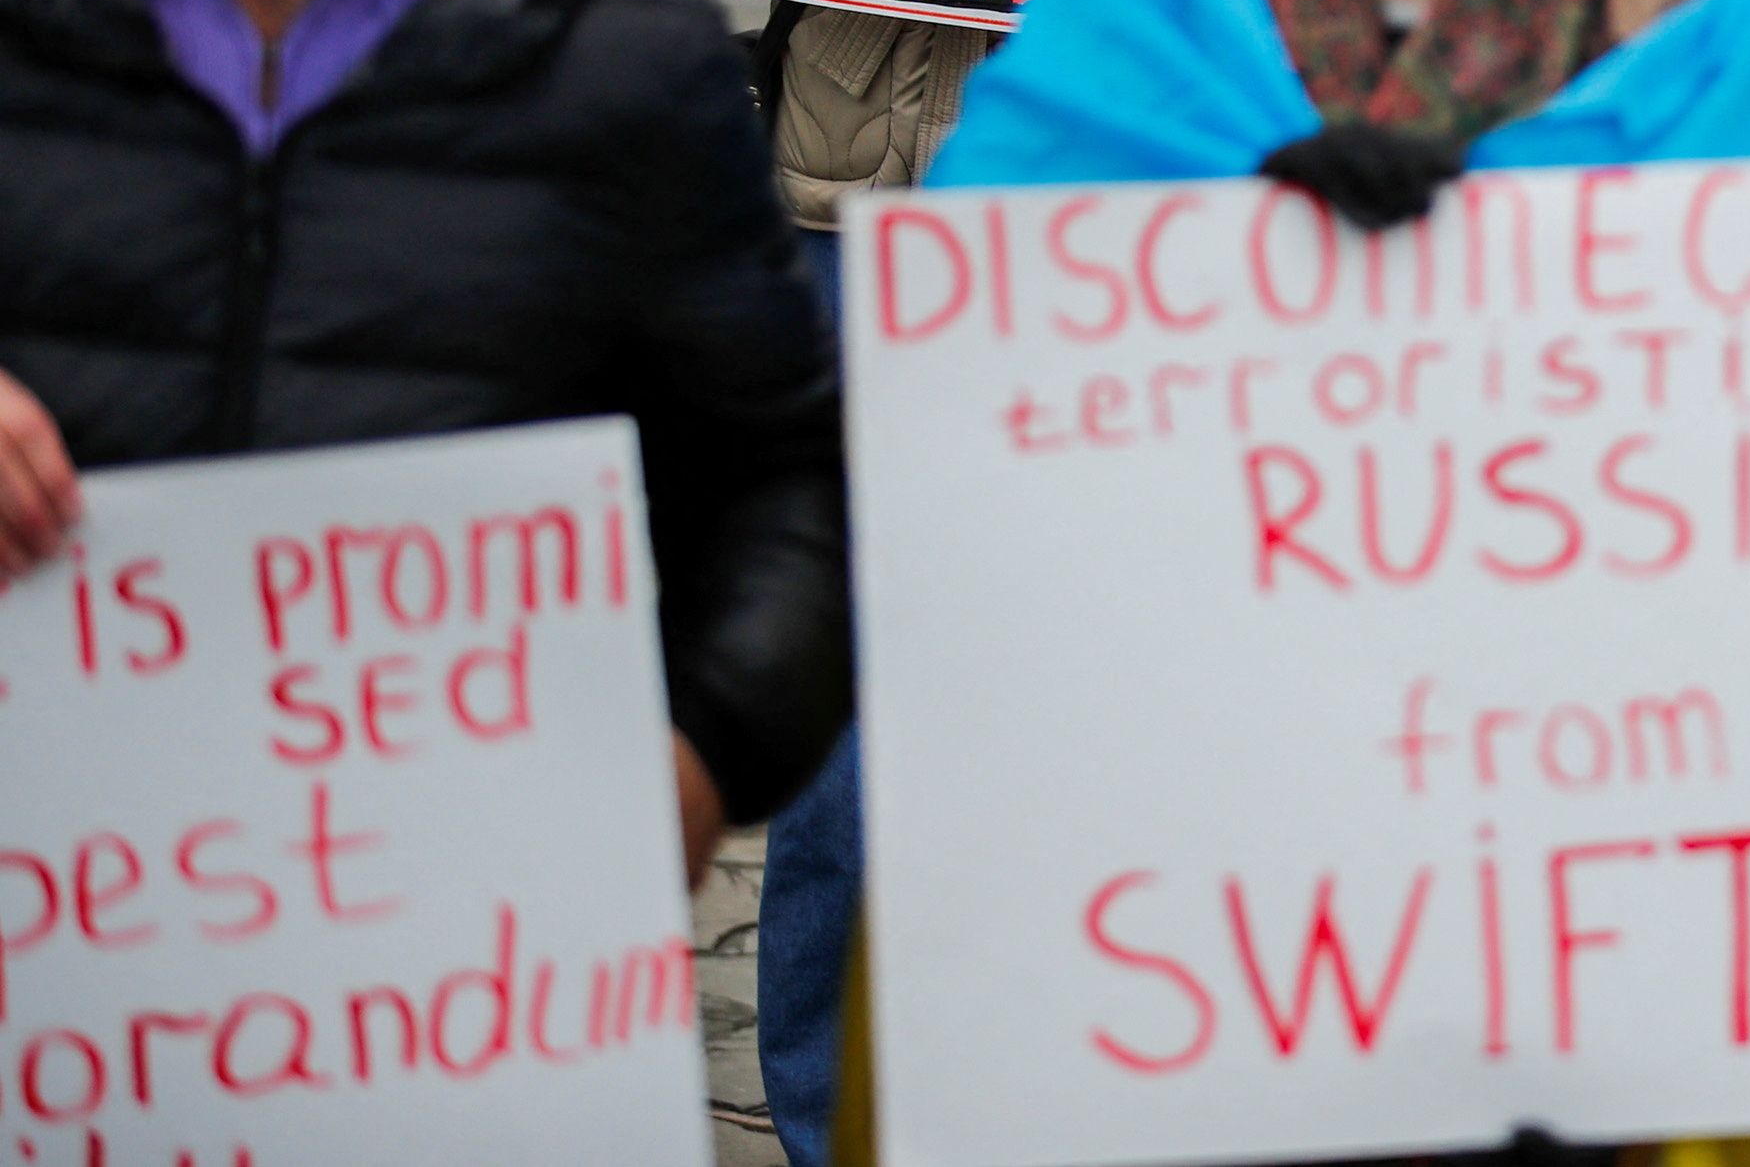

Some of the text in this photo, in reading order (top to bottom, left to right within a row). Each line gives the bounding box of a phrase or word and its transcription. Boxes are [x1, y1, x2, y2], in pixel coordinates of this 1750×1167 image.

[254, 469, 630, 655] promi
[1386, 676, 1730, 793] from
[0, 899, 694, 1124] orandum
